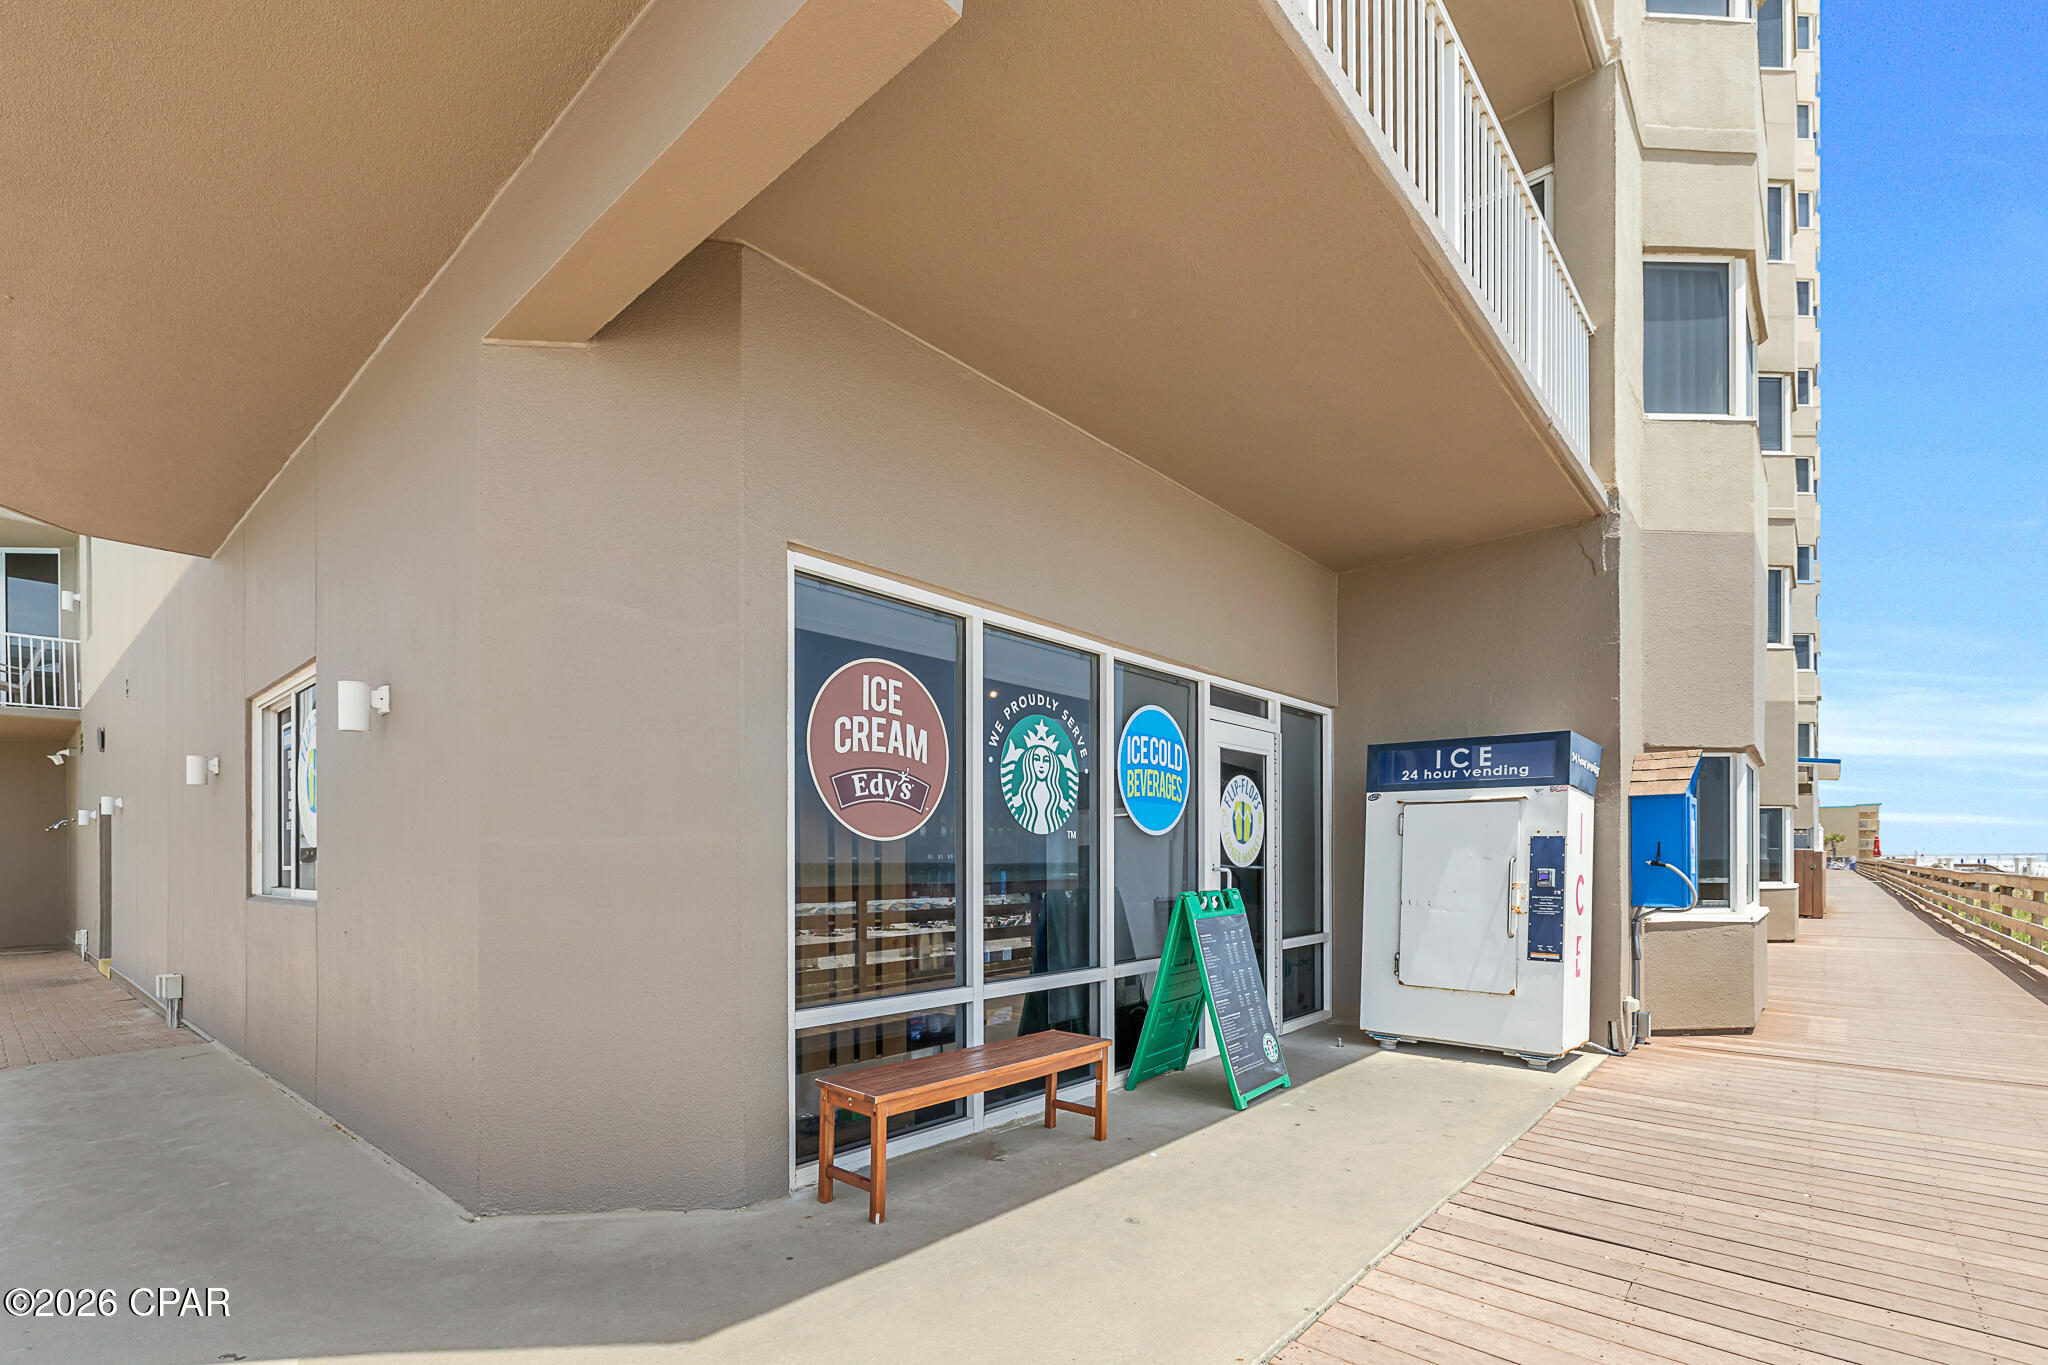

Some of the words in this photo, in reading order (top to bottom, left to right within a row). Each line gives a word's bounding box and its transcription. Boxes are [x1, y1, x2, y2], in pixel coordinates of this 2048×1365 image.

[863, 674, 903, 717] ICE
[834, 715, 928, 764] CREAM
[989, 720, 1005, 748] WE
[1003, 693, 1060, 720] PROUDLY
[1061, 709, 1088, 758] SERVE
[1127, 735, 1149, 765] ICE
[1149, 736, 1183, 772] COLD
[1436, 746, 1492, 769] ICE
[851, 768, 915, 802] Edy's
[1127, 768, 1183, 803] BEVERAGES
[1401, 770, 1419, 781] 24
[1424, 768, 1457, 780] hour
[1463, 764, 1529, 778] vending
[1224, 778, 1262, 810] FLIP-FLOPS
[1066, 830, 1077, 839] TM
